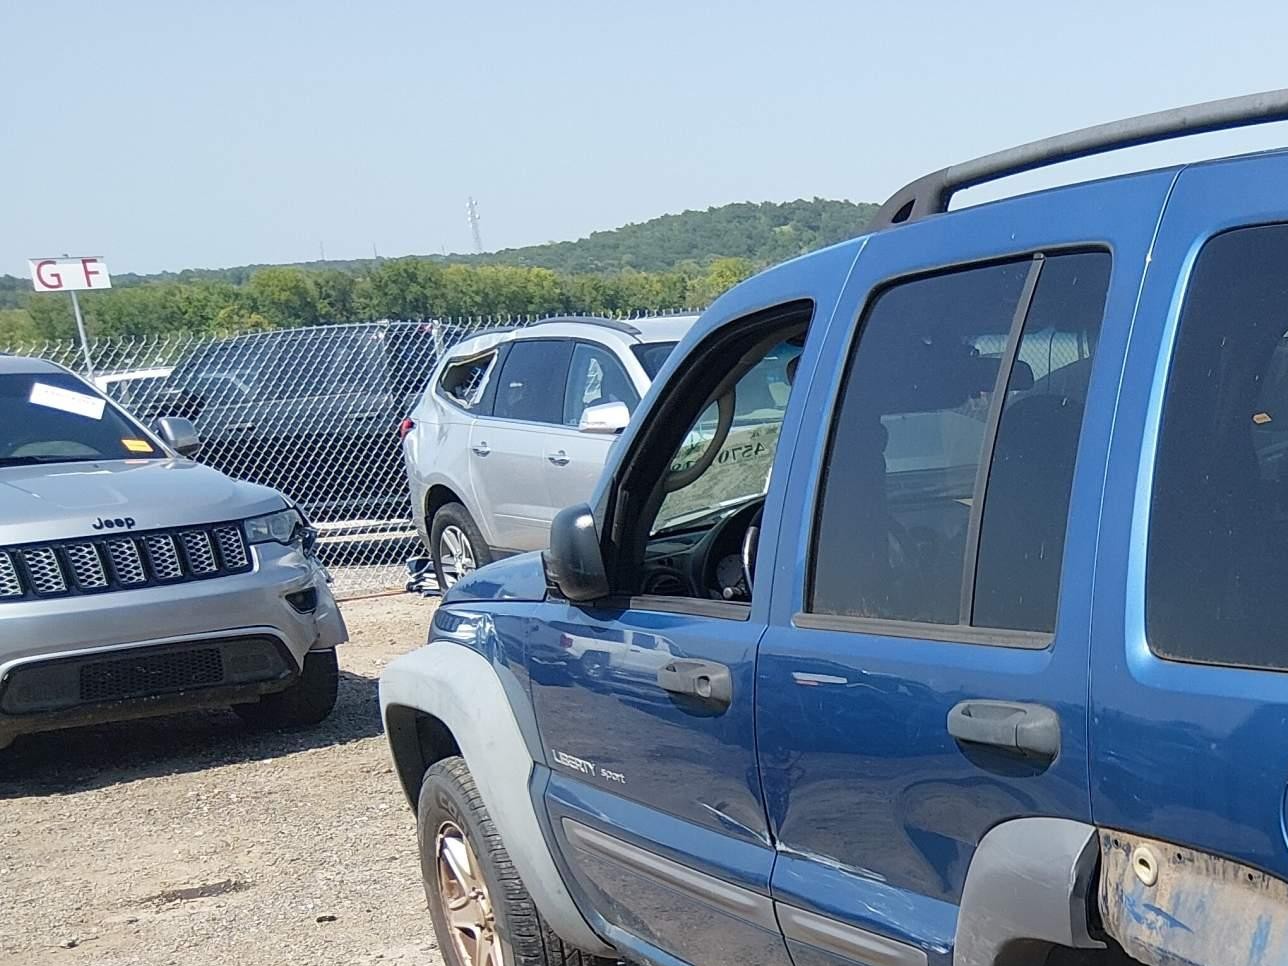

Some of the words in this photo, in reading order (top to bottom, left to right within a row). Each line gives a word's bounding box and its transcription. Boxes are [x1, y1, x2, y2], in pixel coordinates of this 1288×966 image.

[36, 259, 63, 289] G
[81, 258, 99, 288] F
[92, 516, 136, 530] Jeep
